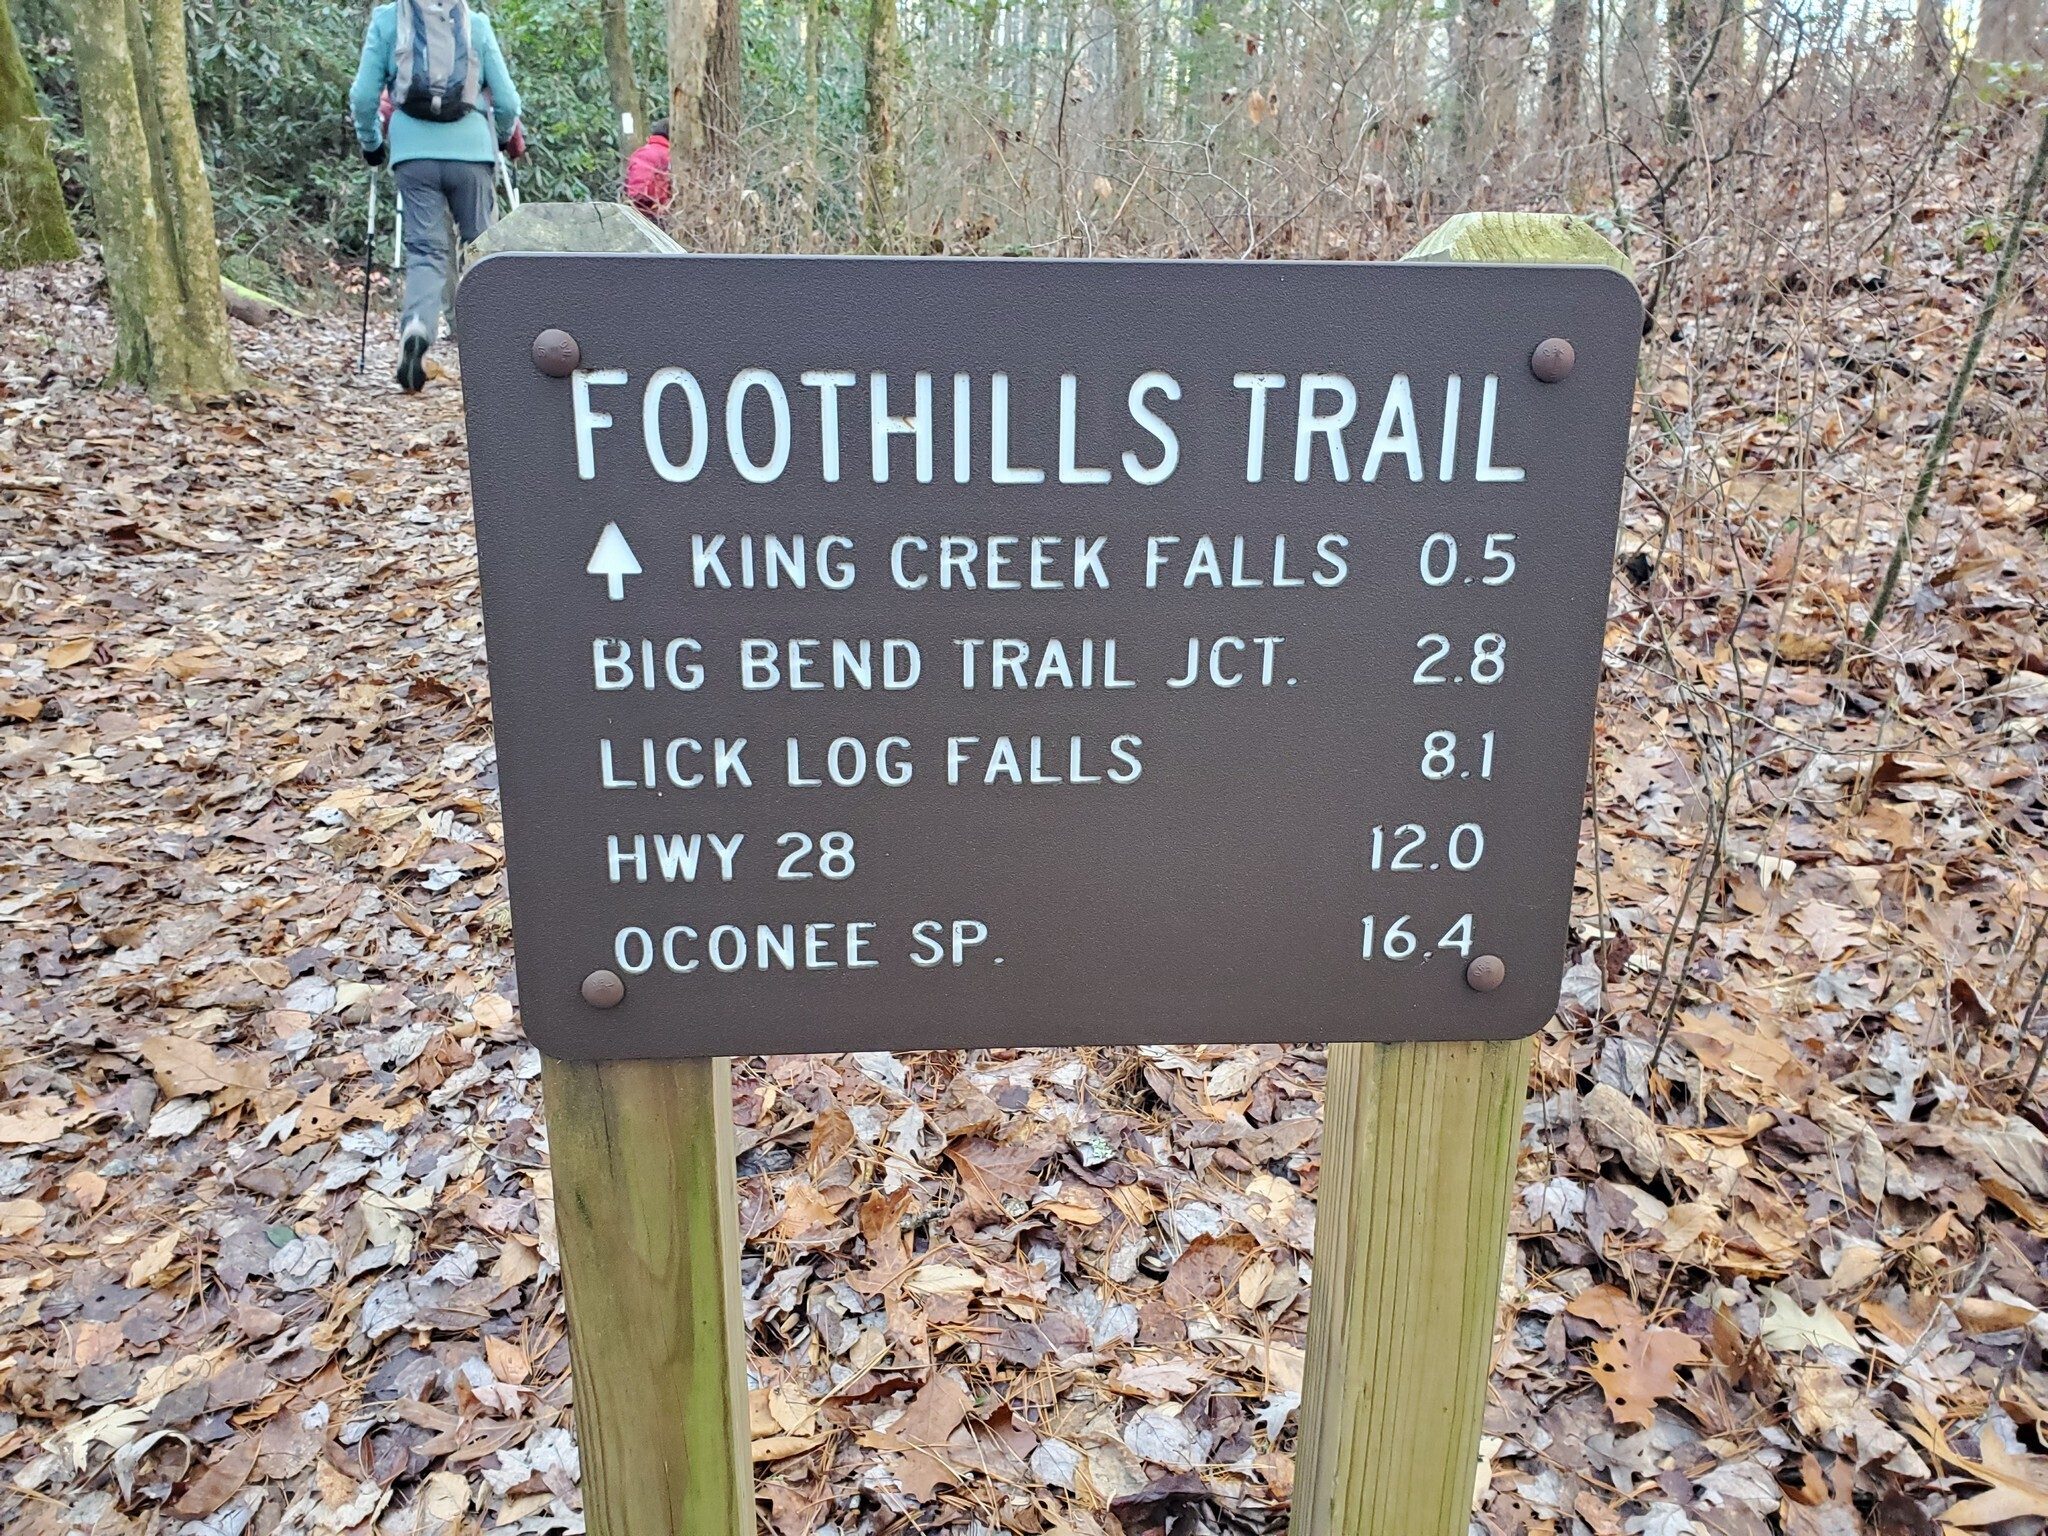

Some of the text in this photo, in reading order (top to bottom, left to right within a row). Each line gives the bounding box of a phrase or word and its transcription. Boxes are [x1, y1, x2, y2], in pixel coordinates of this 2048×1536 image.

[571, 367, 1527, 487] FOOTHILLS TRAIL
[690, 531, 1518, 592] KING CREEK FALLS 0.5
[592, 632, 1508, 692] BIG BEND TRAIL JCT. 2.8
[599, 729, 1496, 790] LICK LOG FALLS 8.1
[606, 822, 1486, 884] HWY 28 12.0
[613, 912, 1475, 975] OCONEE SP. 16.4
